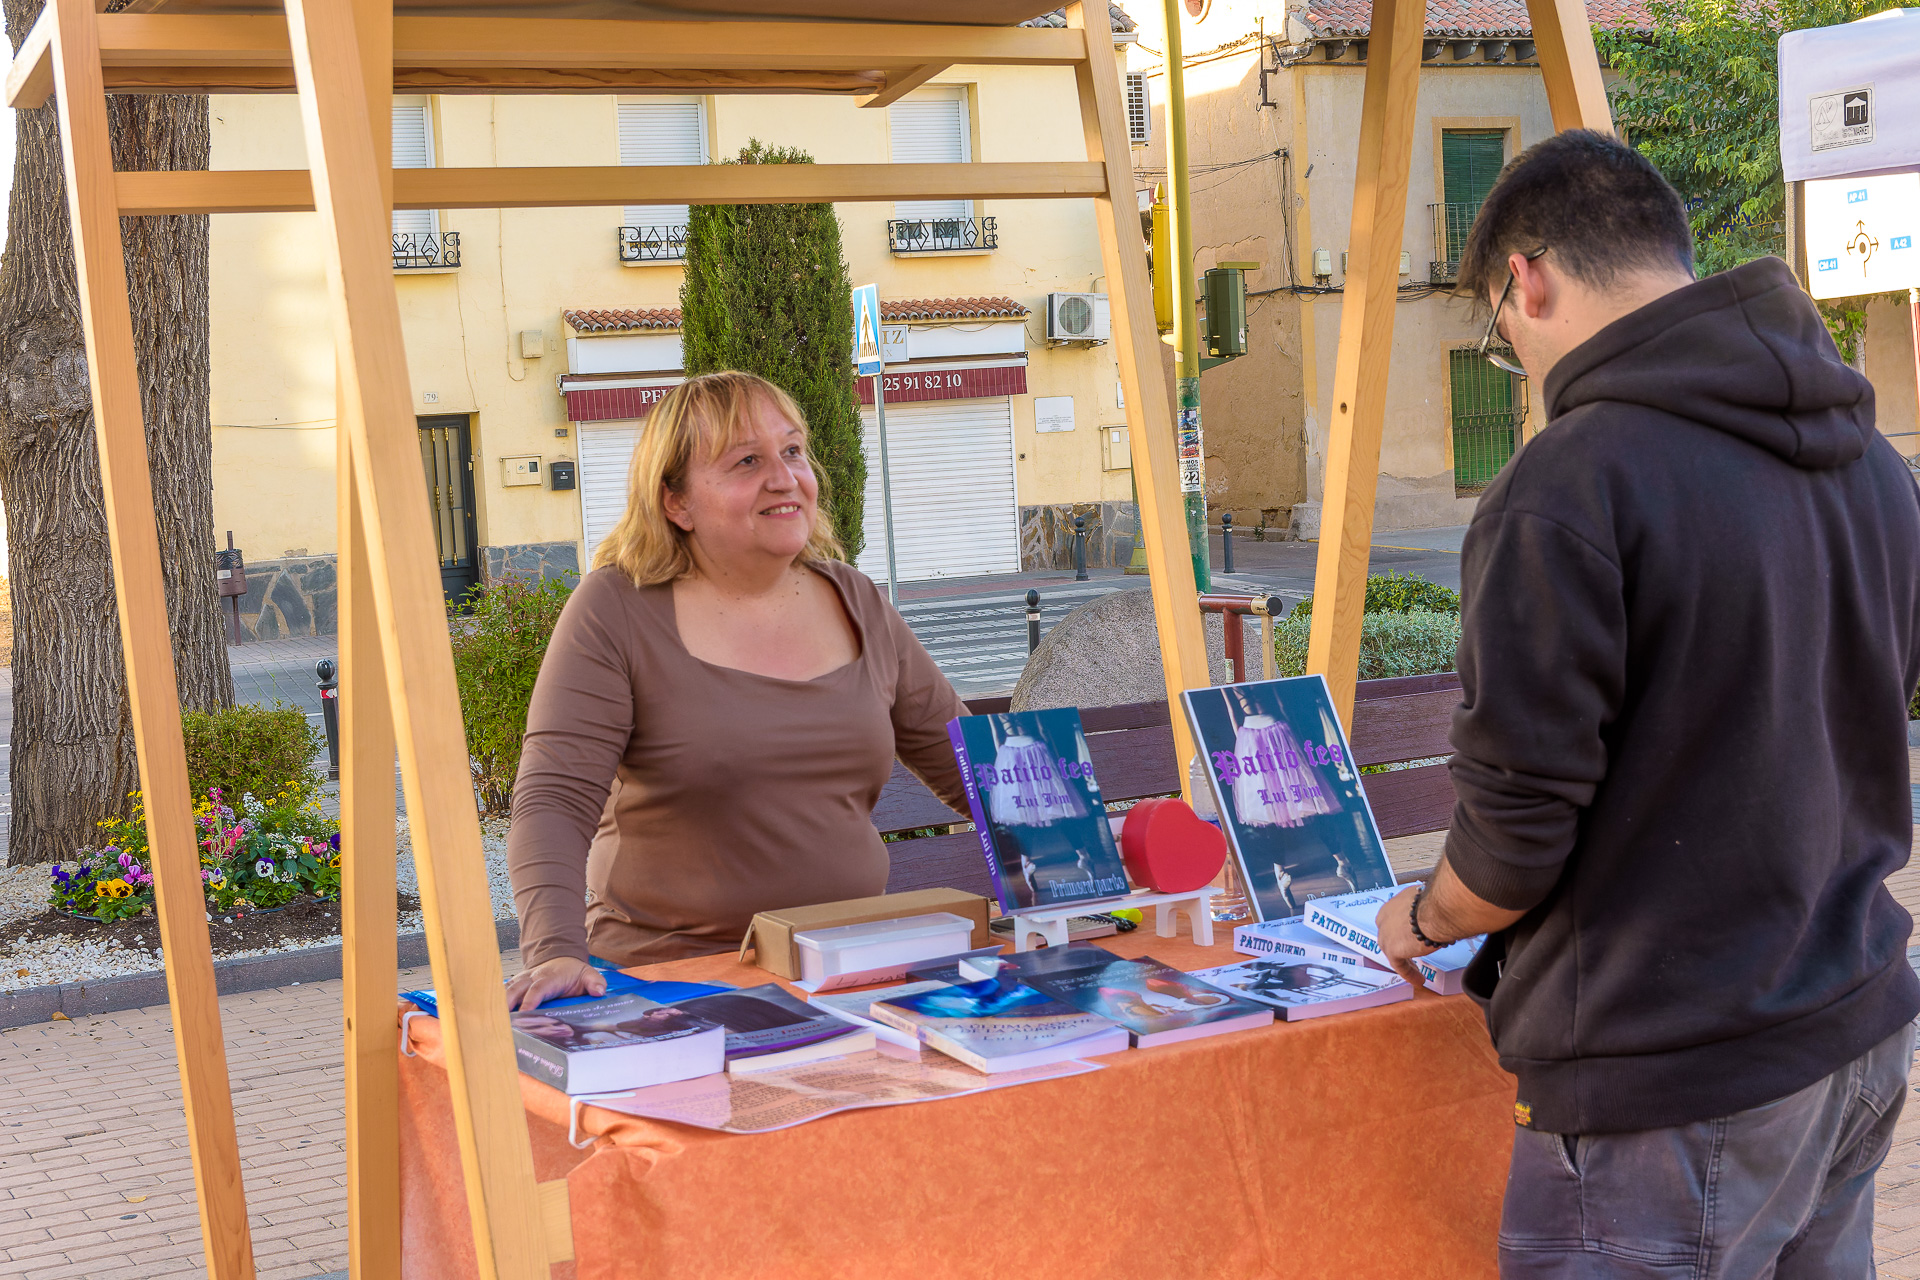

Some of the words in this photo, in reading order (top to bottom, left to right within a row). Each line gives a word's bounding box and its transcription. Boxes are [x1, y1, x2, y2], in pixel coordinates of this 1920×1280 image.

[1858, 190, 1866, 201] 41
[1900, 237, 1908, 248] 42
[903, 376, 920, 390] 91
[924, 375, 942, 389] 82
[945, 373, 962, 388] 10
[1184, 471, 1199, 484] 22
[954, 742, 970, 781] Patito
[1211, 746, 1299, 785] Patito
[1304, 739, 1344, 767] feo
[974, 763, 1052, 792] Patito
[1058, 757, 1093, 779] feo
[1012, 794, 1039, 809] Lui
[1042, 792, 1070, 808] Jim
[1257, 789, 1287, 806] Lui
[1290, 784, 1322, 803] Jim
[980, 830, 991, 853] Lui
[986, 853, 997, 876] Jim
[1050, 878, 1094, 898] Primera
[1094, 873, 1125, 896] parte
[1239, 934, 1273, 953] PATITO
[1310, 910, 1348, 937] PATITO
[1348, 929, 1382, 955] BUENO
